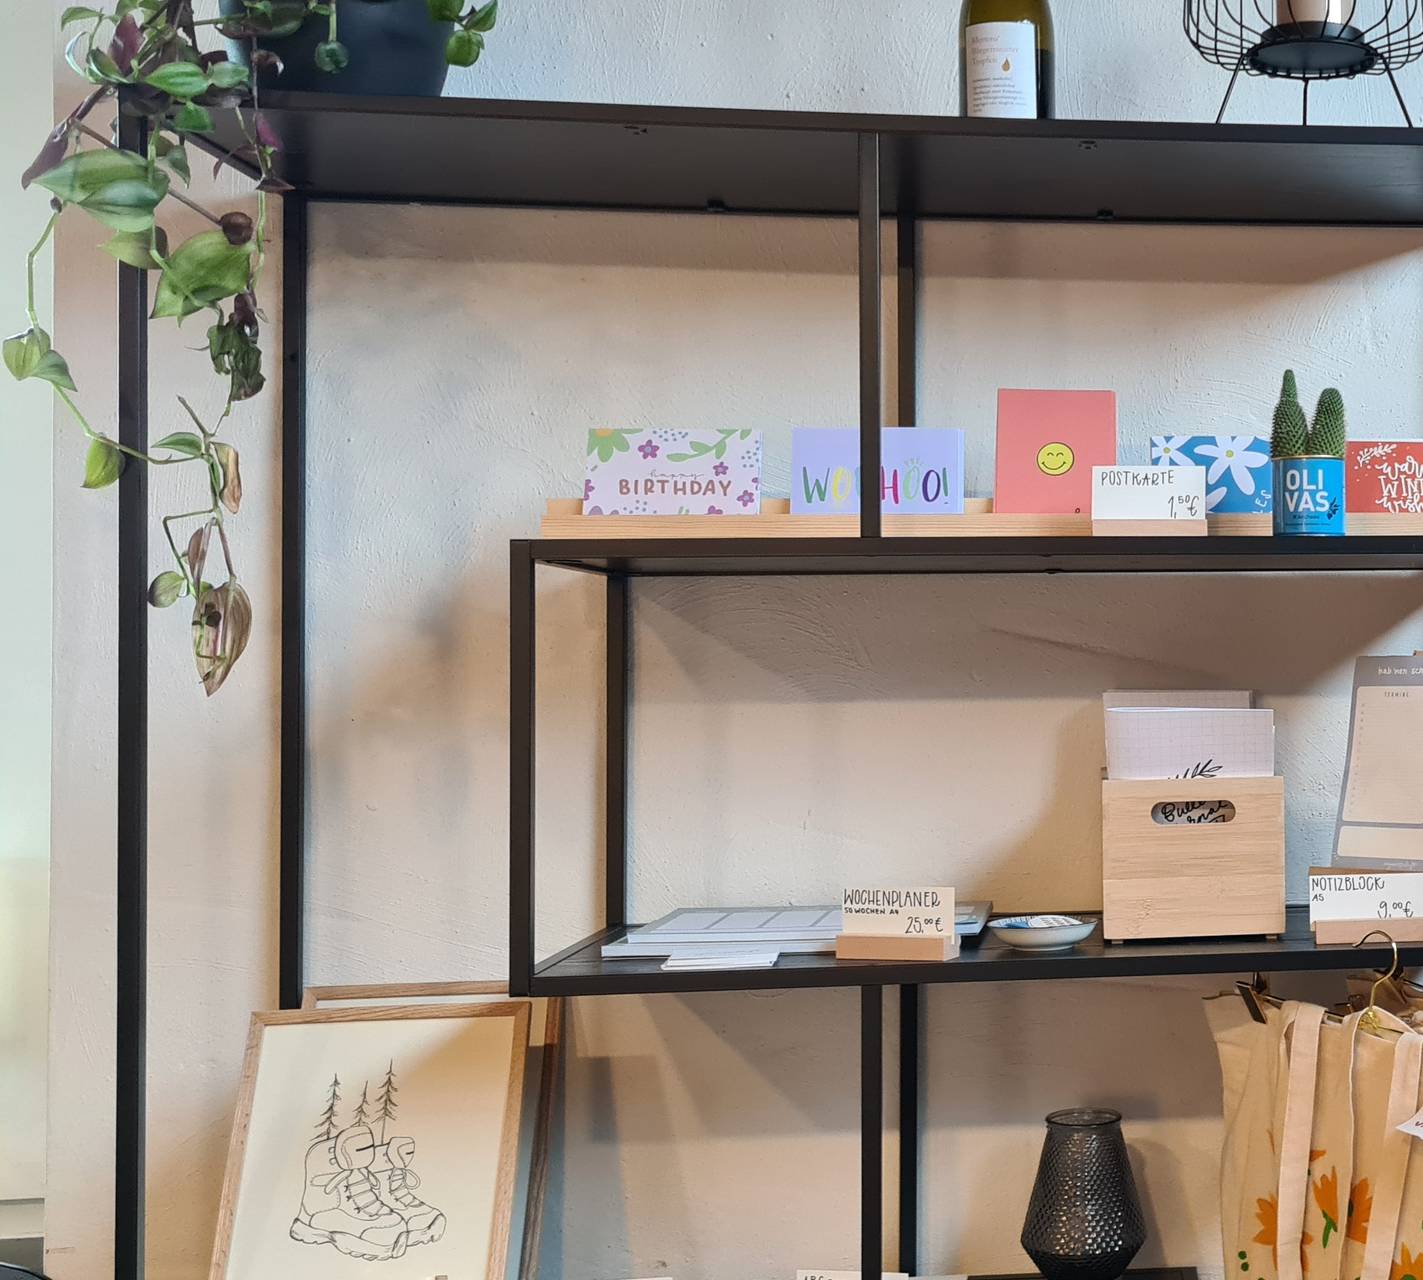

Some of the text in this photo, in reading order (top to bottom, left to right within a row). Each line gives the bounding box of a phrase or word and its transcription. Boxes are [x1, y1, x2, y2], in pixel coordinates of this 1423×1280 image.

[618, 478, 732, 496] BIRTHDAY
[802, 464, 949, 505] WOHOO!
[1101, 470, 1175, 487] POSTKARTE
[1285, 469, 1324, 490] OLI
[1285, 491, 1331, 513] VAS
[1311, 876, 1385, 892] NOTIZBLOCK
[843, 888, 941, 908] WOCHENPLANER
[1311, 893, 1325, 902] A5
